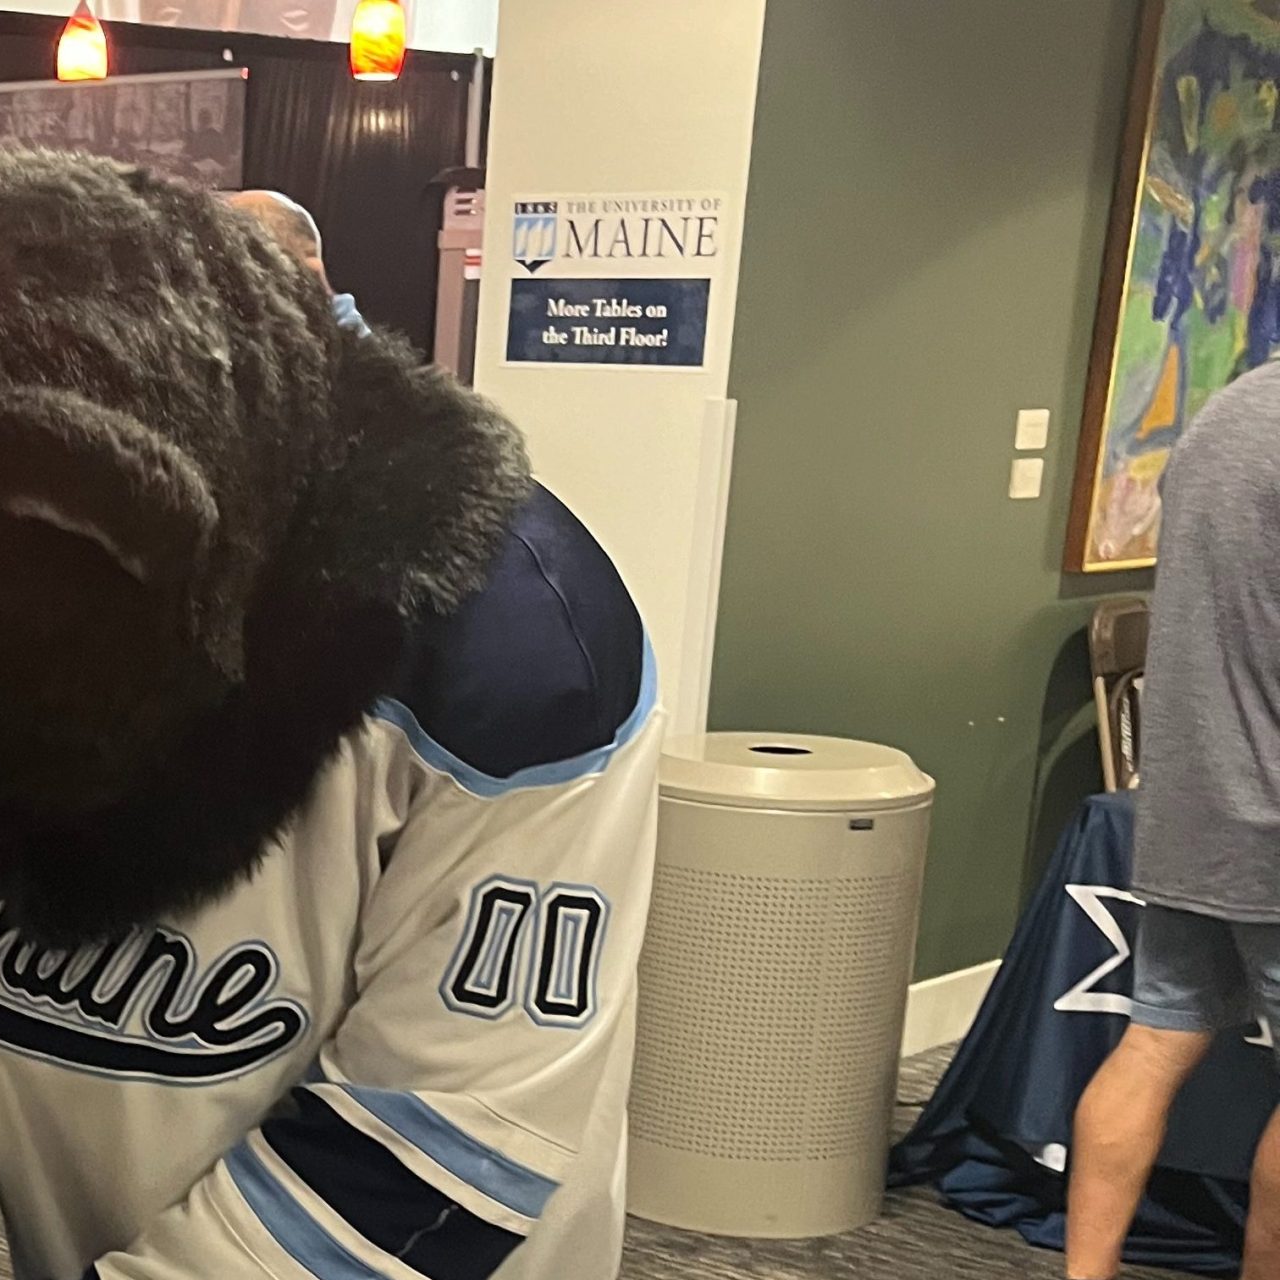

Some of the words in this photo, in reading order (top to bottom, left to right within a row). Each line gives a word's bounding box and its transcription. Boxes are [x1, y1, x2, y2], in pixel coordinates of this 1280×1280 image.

[567, 201, 596, 214] THE
[602, 199, 694, 214] UNIVERSITY
[700, 198, 721, 211] OF
[562, 216, 718, 258] MAINE
[547, 298, 590, 317] More
[592, 298, 642, 318] Tables
[645, 304, 668, 318] on
[542, 325, 568, 345] the
[571, 326, 616, 346] Third
[619, 327, 668, 347] Floor!
[440, 873, 612, 1030] 00
